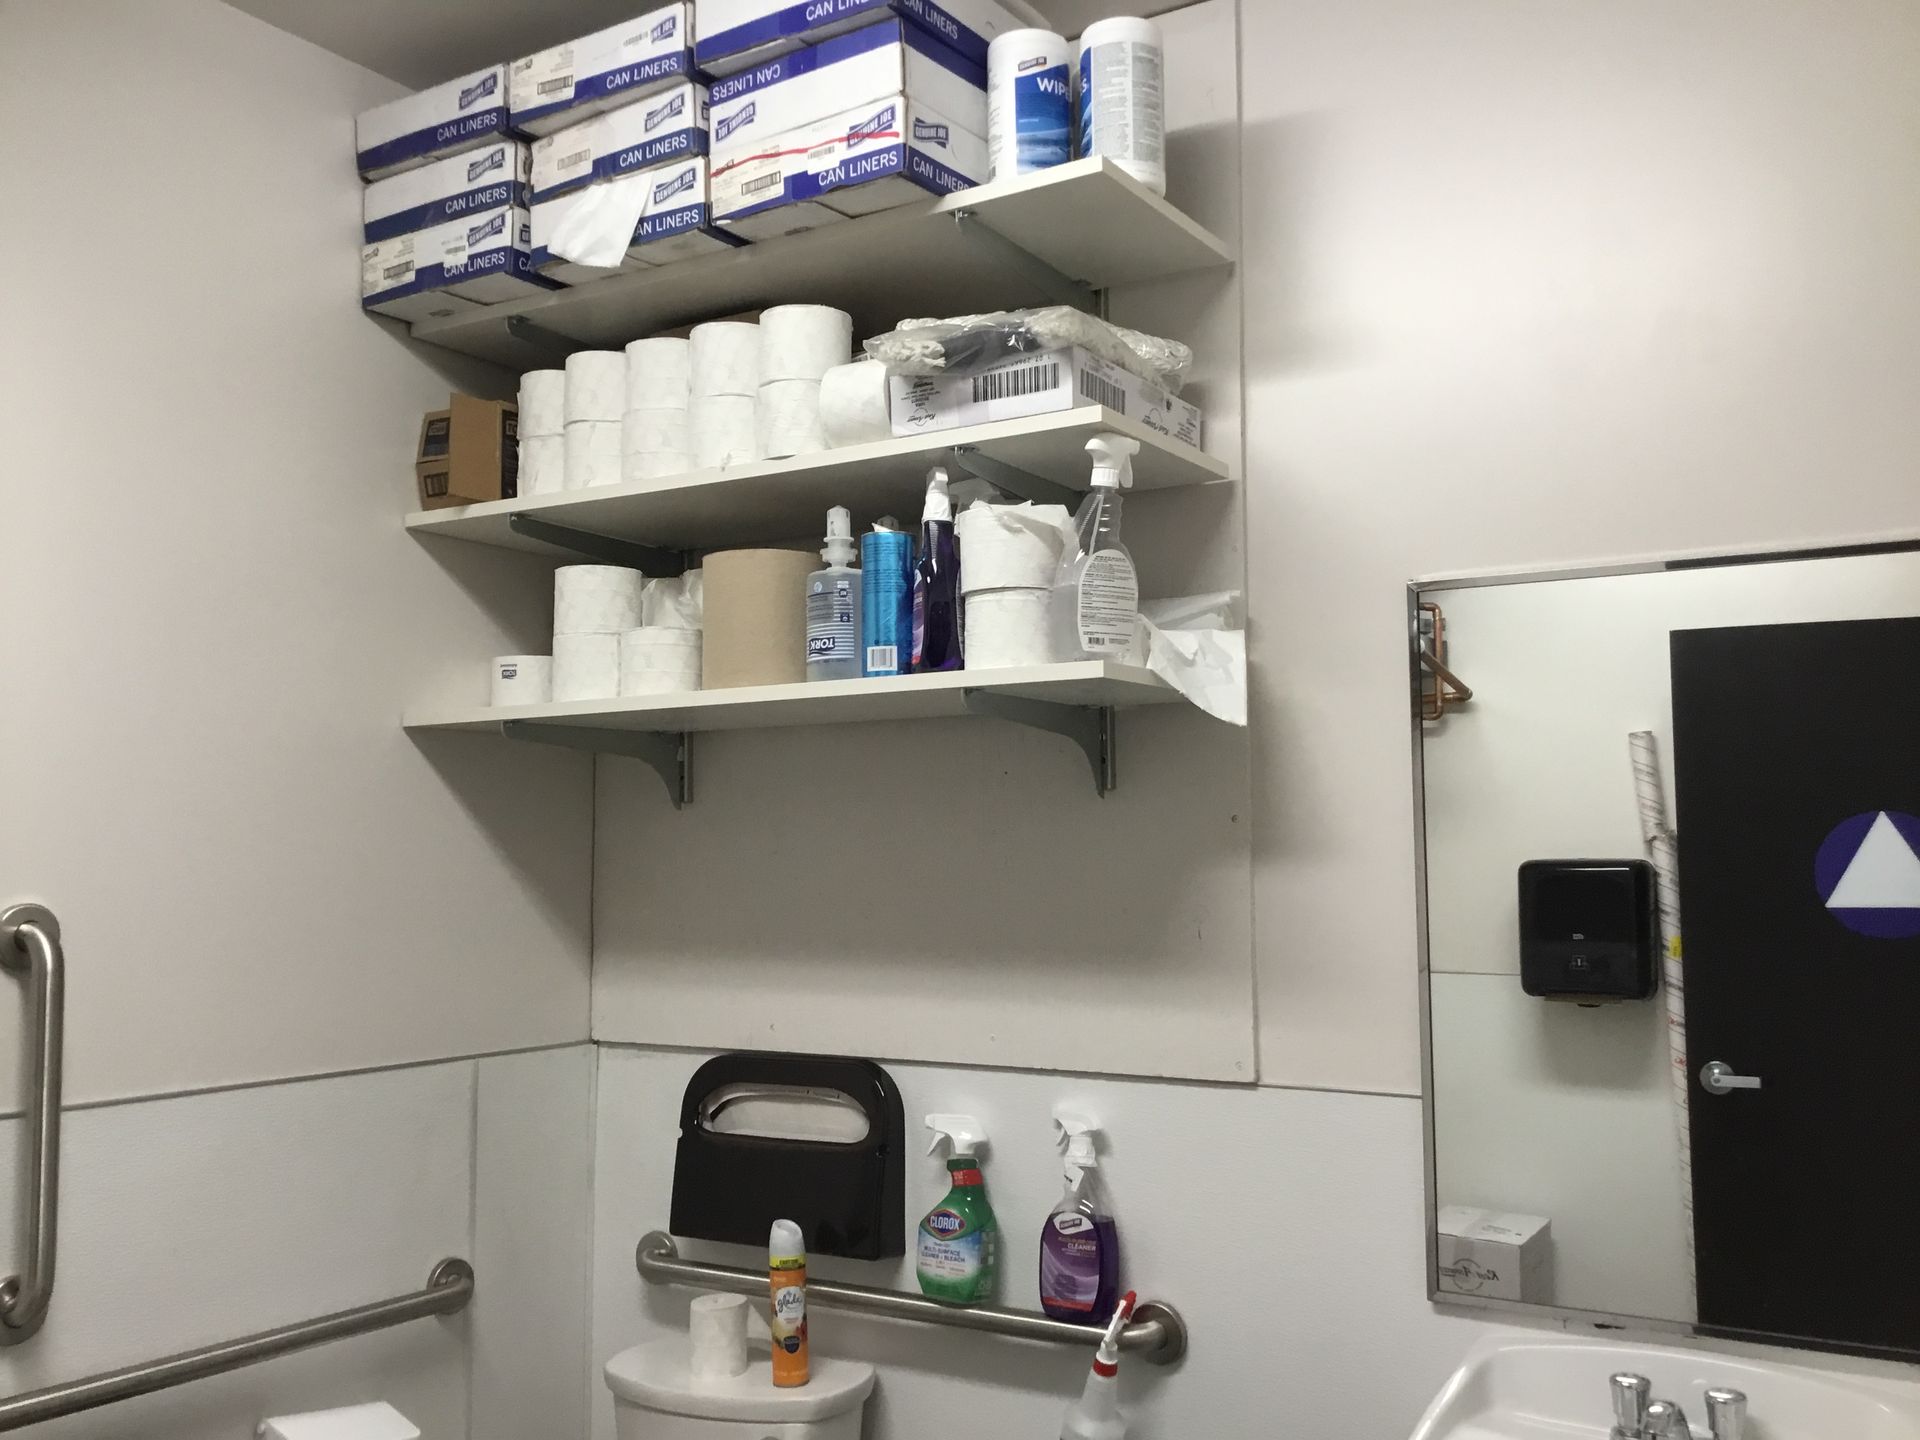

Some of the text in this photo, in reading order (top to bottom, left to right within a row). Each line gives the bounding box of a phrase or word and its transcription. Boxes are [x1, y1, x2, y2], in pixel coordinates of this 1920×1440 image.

[806, 0, 833, 21] CAN
[925, 6, 958, 40] LINERS
[606, 57, 678, 90] CAN LINERS
[713, 66, 782, 101] CAN LINERS
[437, 112, 498, 142] CAN LINERS
[619, 133, 688, 168] CAN LINERS
[818, 166, 845, 187] CAN
[850, 150, 898, 177] LINERS
[913, 156, 934, 179] CAN
[445, 186, 508, 215] CAN LINERS
[635, 208, 700, 236] AN LINERS
[443, 251, 506, 278] CAN LINERS
[809, 638, 835, 650] TORK
[929, 1215, 960, 1230] CLOROX
[1067, 1242, 1097, 1252] CLEANER
[776, 1293, 802, 1313] glade
